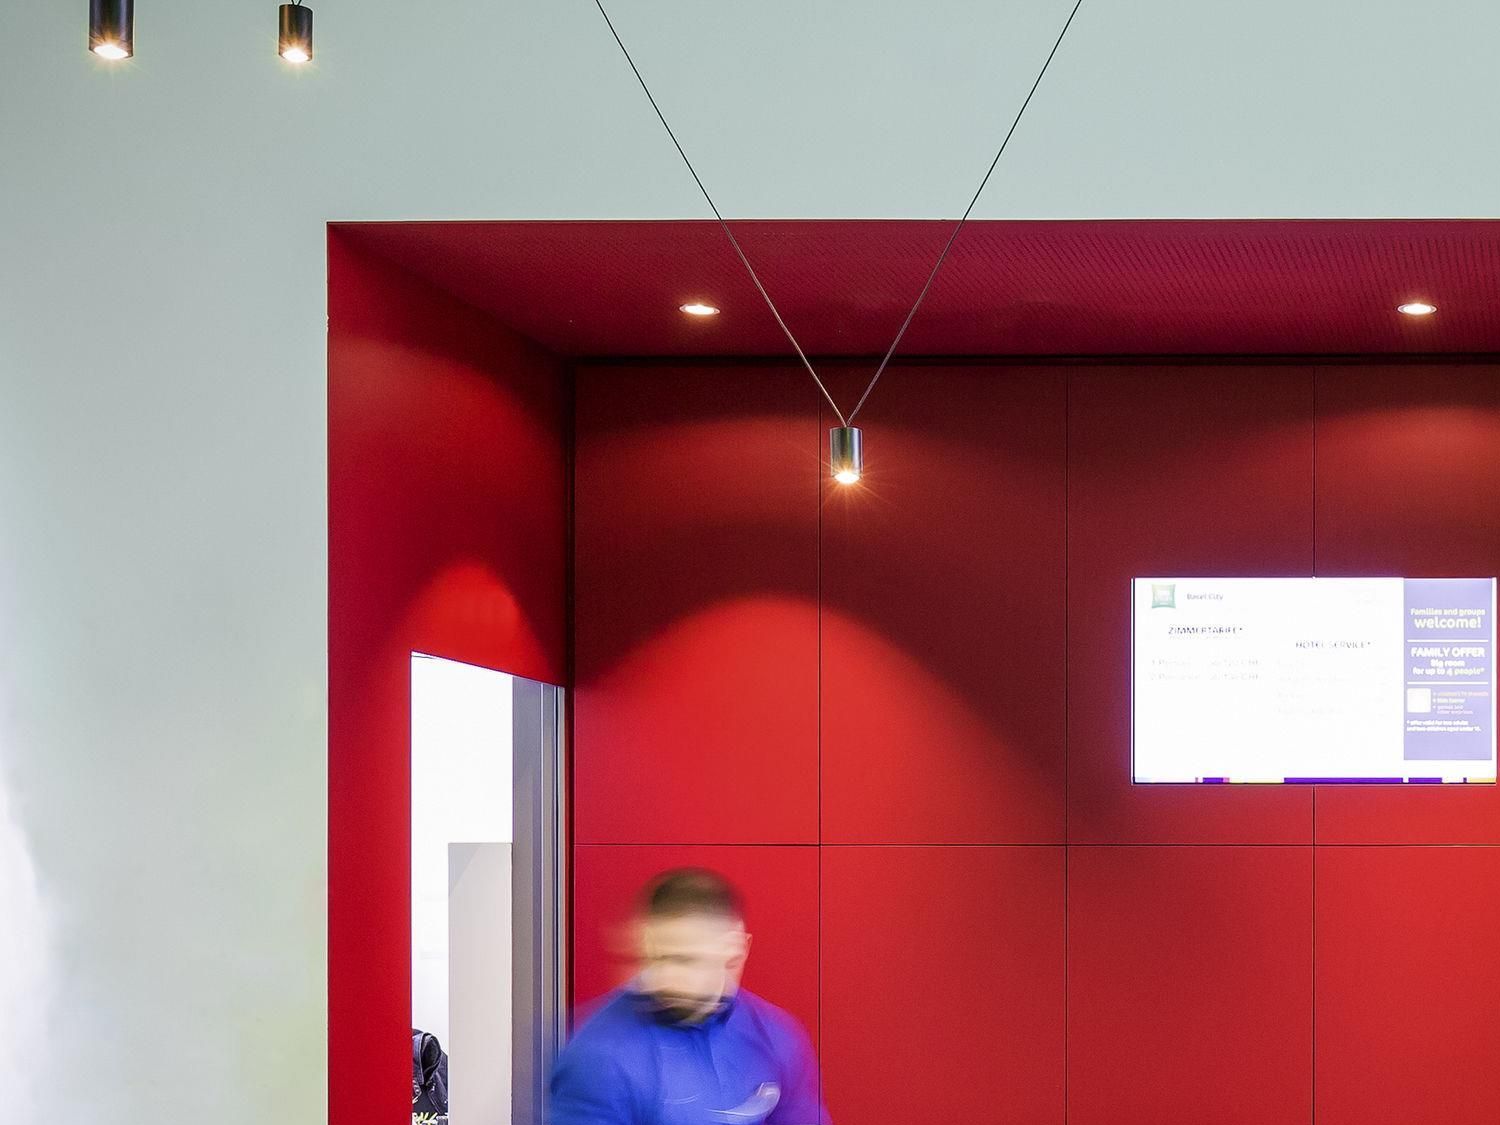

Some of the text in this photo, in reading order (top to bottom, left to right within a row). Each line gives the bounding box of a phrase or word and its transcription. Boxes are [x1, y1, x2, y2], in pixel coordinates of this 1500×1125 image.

[1208, 593, 1224, 602] City
[1410, 608, 1486, 617] Families and groups
[1414, 616, 1482, 628] welcome!
[1410, 646, 1486, 658] FAMILY OFFER
[1412, 667, 1424, 675] for
[1425, 668, 1436, 676] up
[1436, 667, 1446, 675] to
